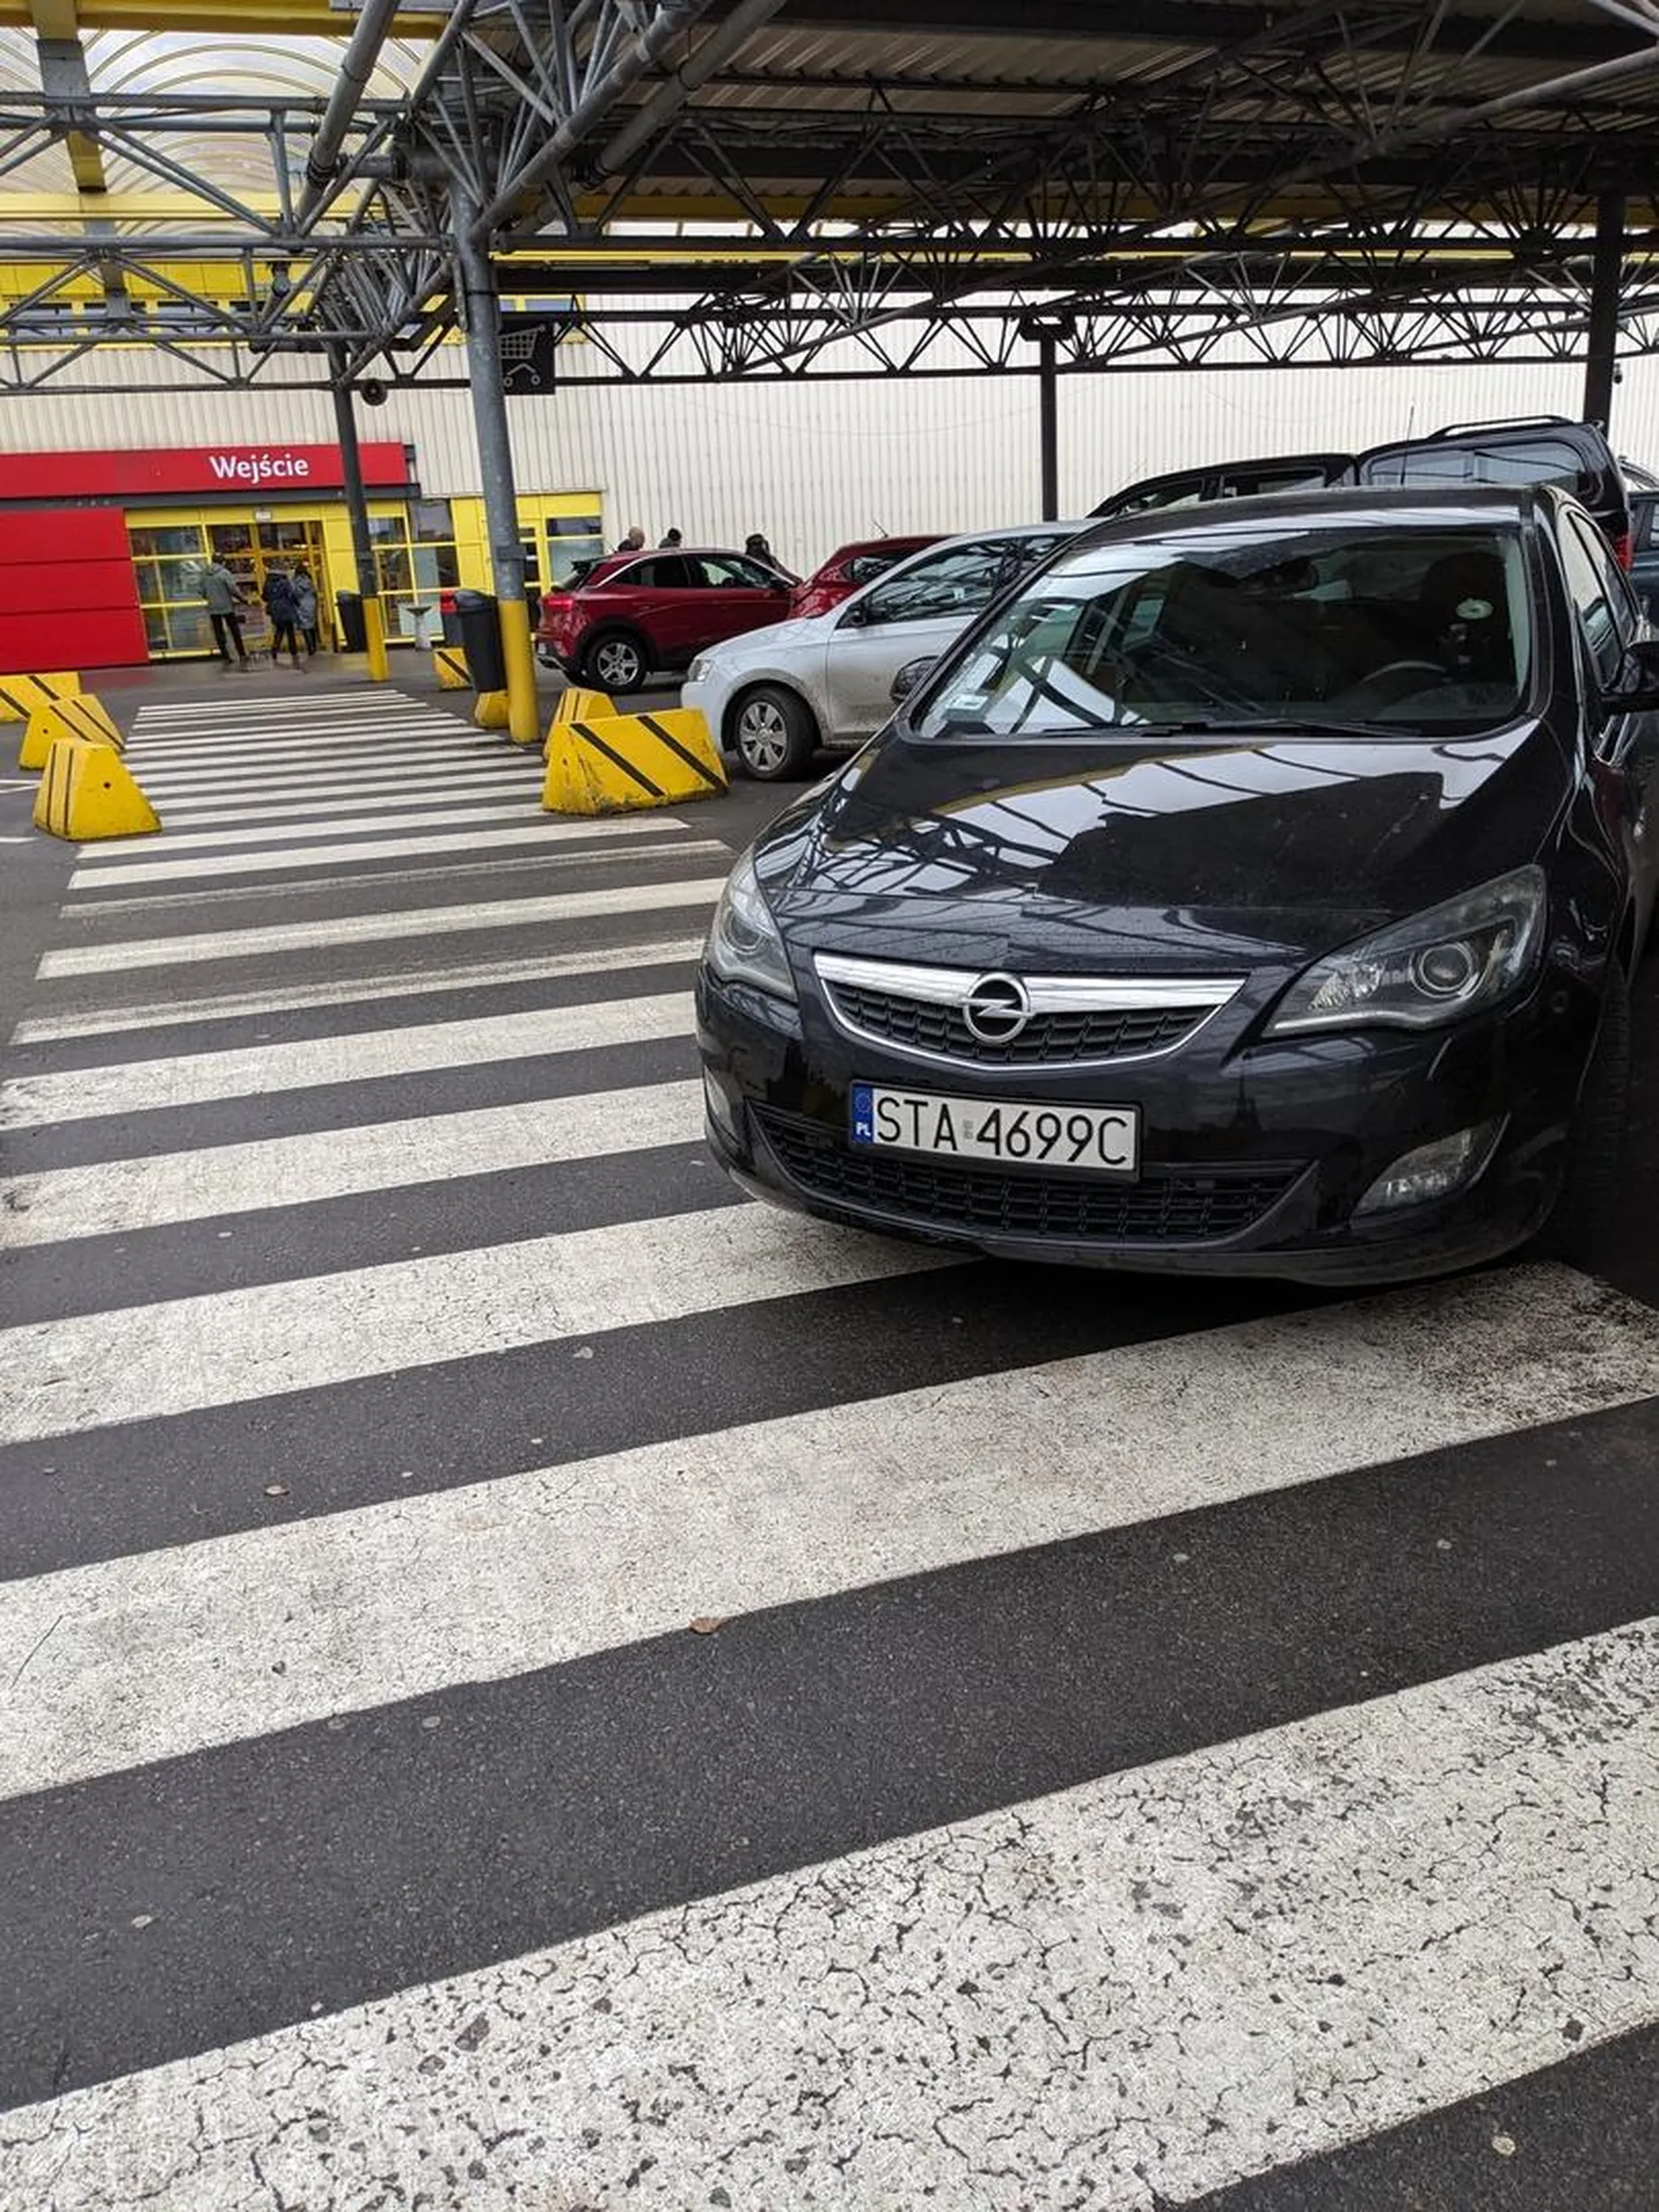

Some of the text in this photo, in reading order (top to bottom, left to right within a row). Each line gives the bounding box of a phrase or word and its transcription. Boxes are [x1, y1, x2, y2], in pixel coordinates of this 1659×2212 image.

[209, 455, 309, 484] Wejście
[856, 1122, 872, 1137] PL
[877, 1096, 1128, 1165] STA 4699C
